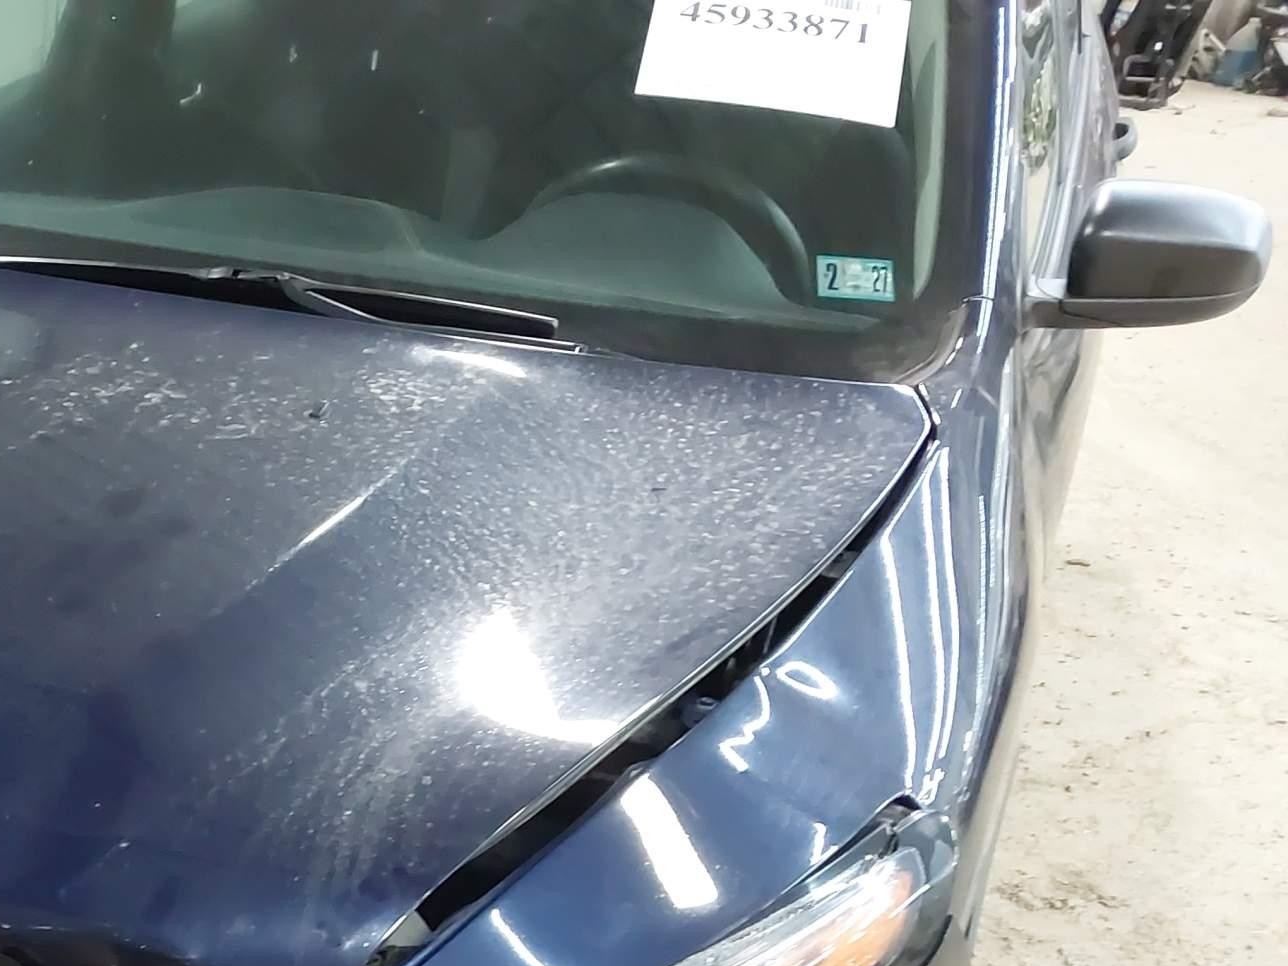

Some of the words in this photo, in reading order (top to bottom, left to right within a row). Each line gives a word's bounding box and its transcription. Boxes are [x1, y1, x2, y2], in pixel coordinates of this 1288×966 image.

[679, 1, 869, 44] 45933871
[825, 262, 840, 291] 2
[871, 265, 889, 293] 27
